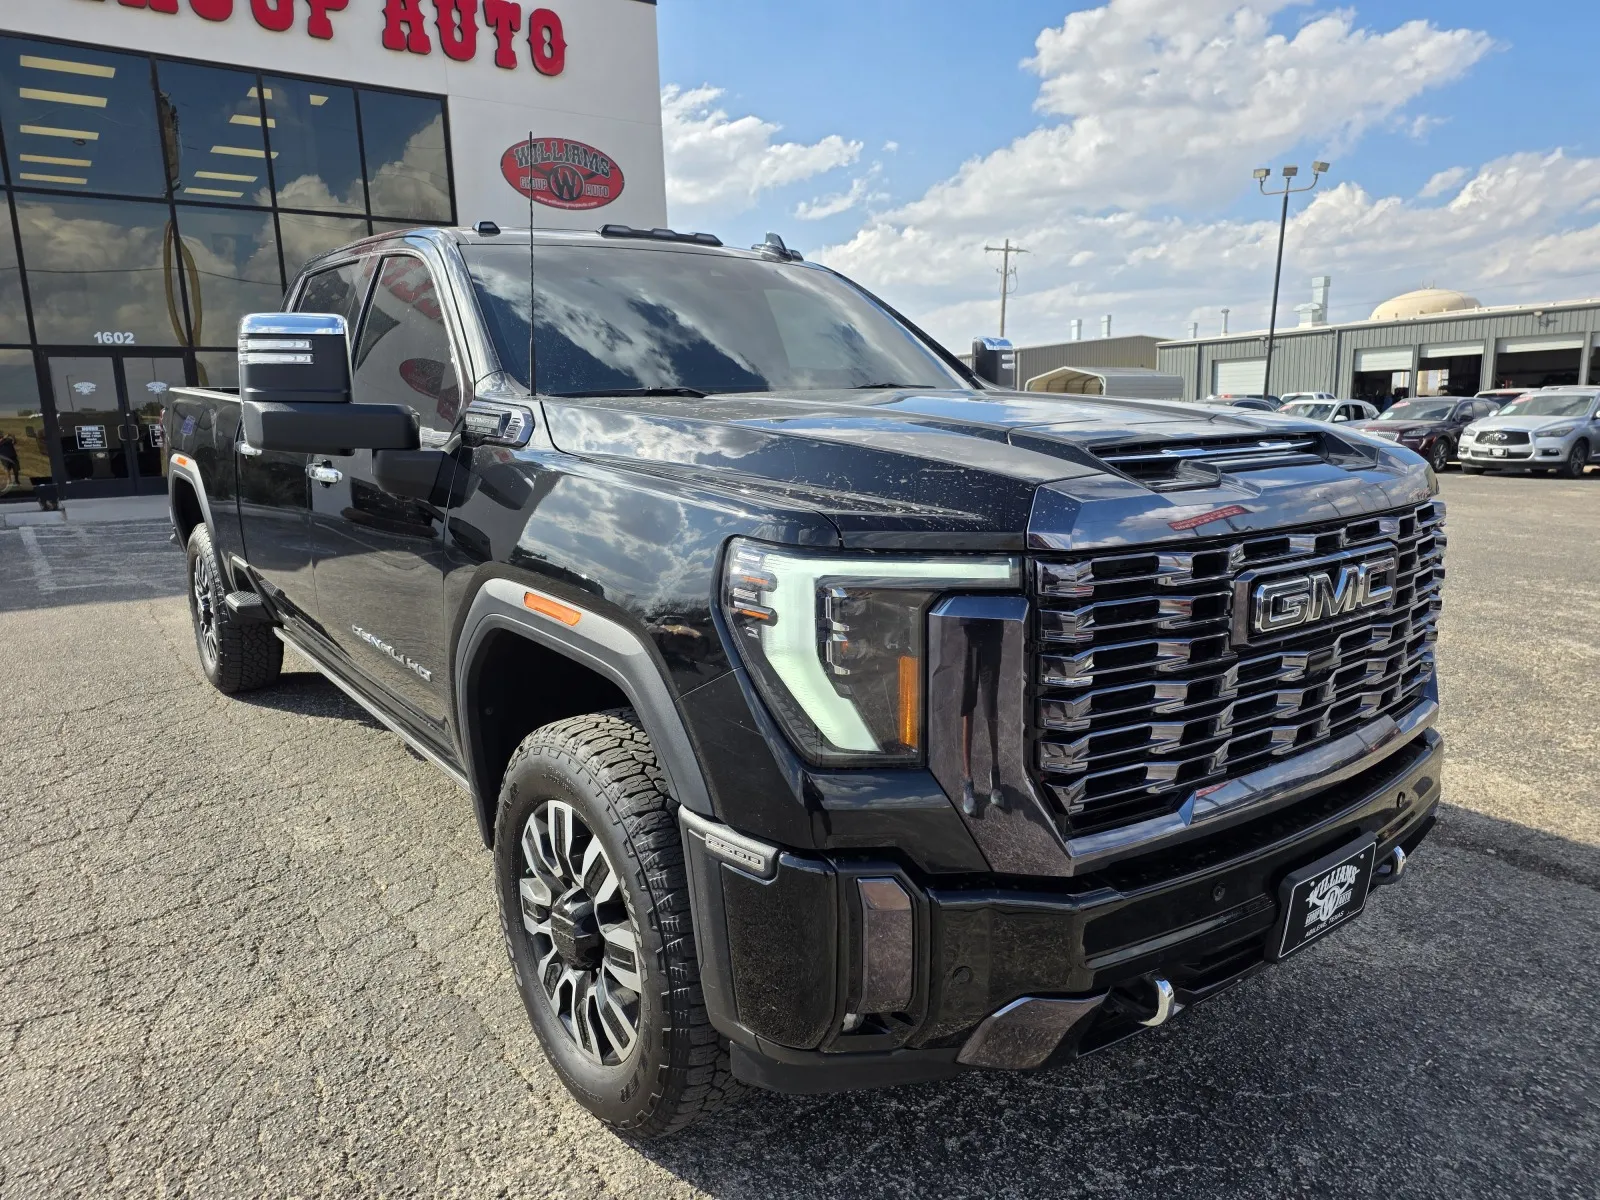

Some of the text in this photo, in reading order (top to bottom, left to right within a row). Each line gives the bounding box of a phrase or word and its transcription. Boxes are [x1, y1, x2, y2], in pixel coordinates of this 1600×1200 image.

[382, 0, 568, 76] AUTO
[514, 141, 610, 178] WILLIAMS
[586, 184, 609, 198] AUTO
[94, 332, 135, 344] 1602
[1255, 557, 1395, 633] GMC
[1308, 864, 1359, 909] WILLIAMS
